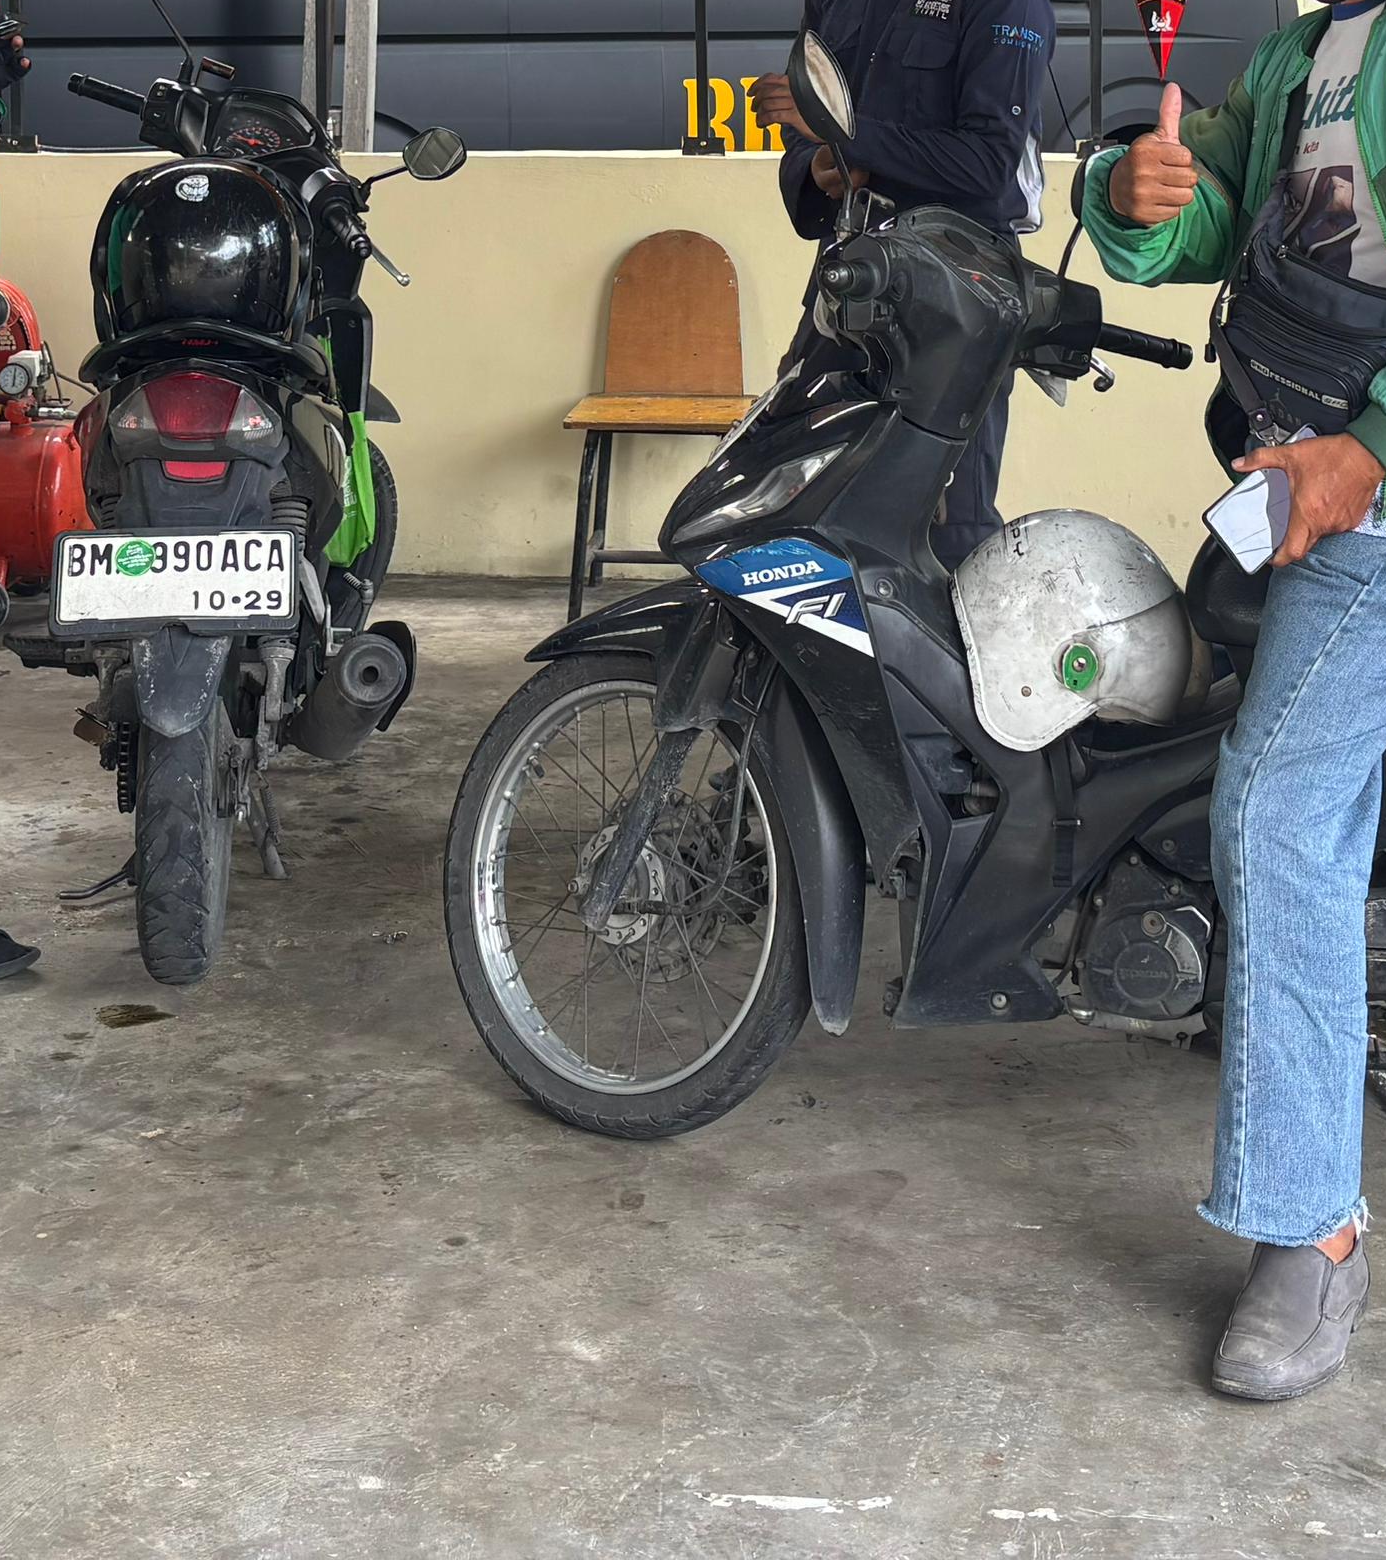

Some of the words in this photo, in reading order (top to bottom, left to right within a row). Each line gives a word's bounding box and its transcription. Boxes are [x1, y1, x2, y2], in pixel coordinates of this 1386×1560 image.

[68, 543, 114, 577] BM
[150, 539, 214, 574] 990
[220, 538, 285, 573] ACA
[741, 559, 825, 587] HONDA
[785, 592, 847, 625] FI
